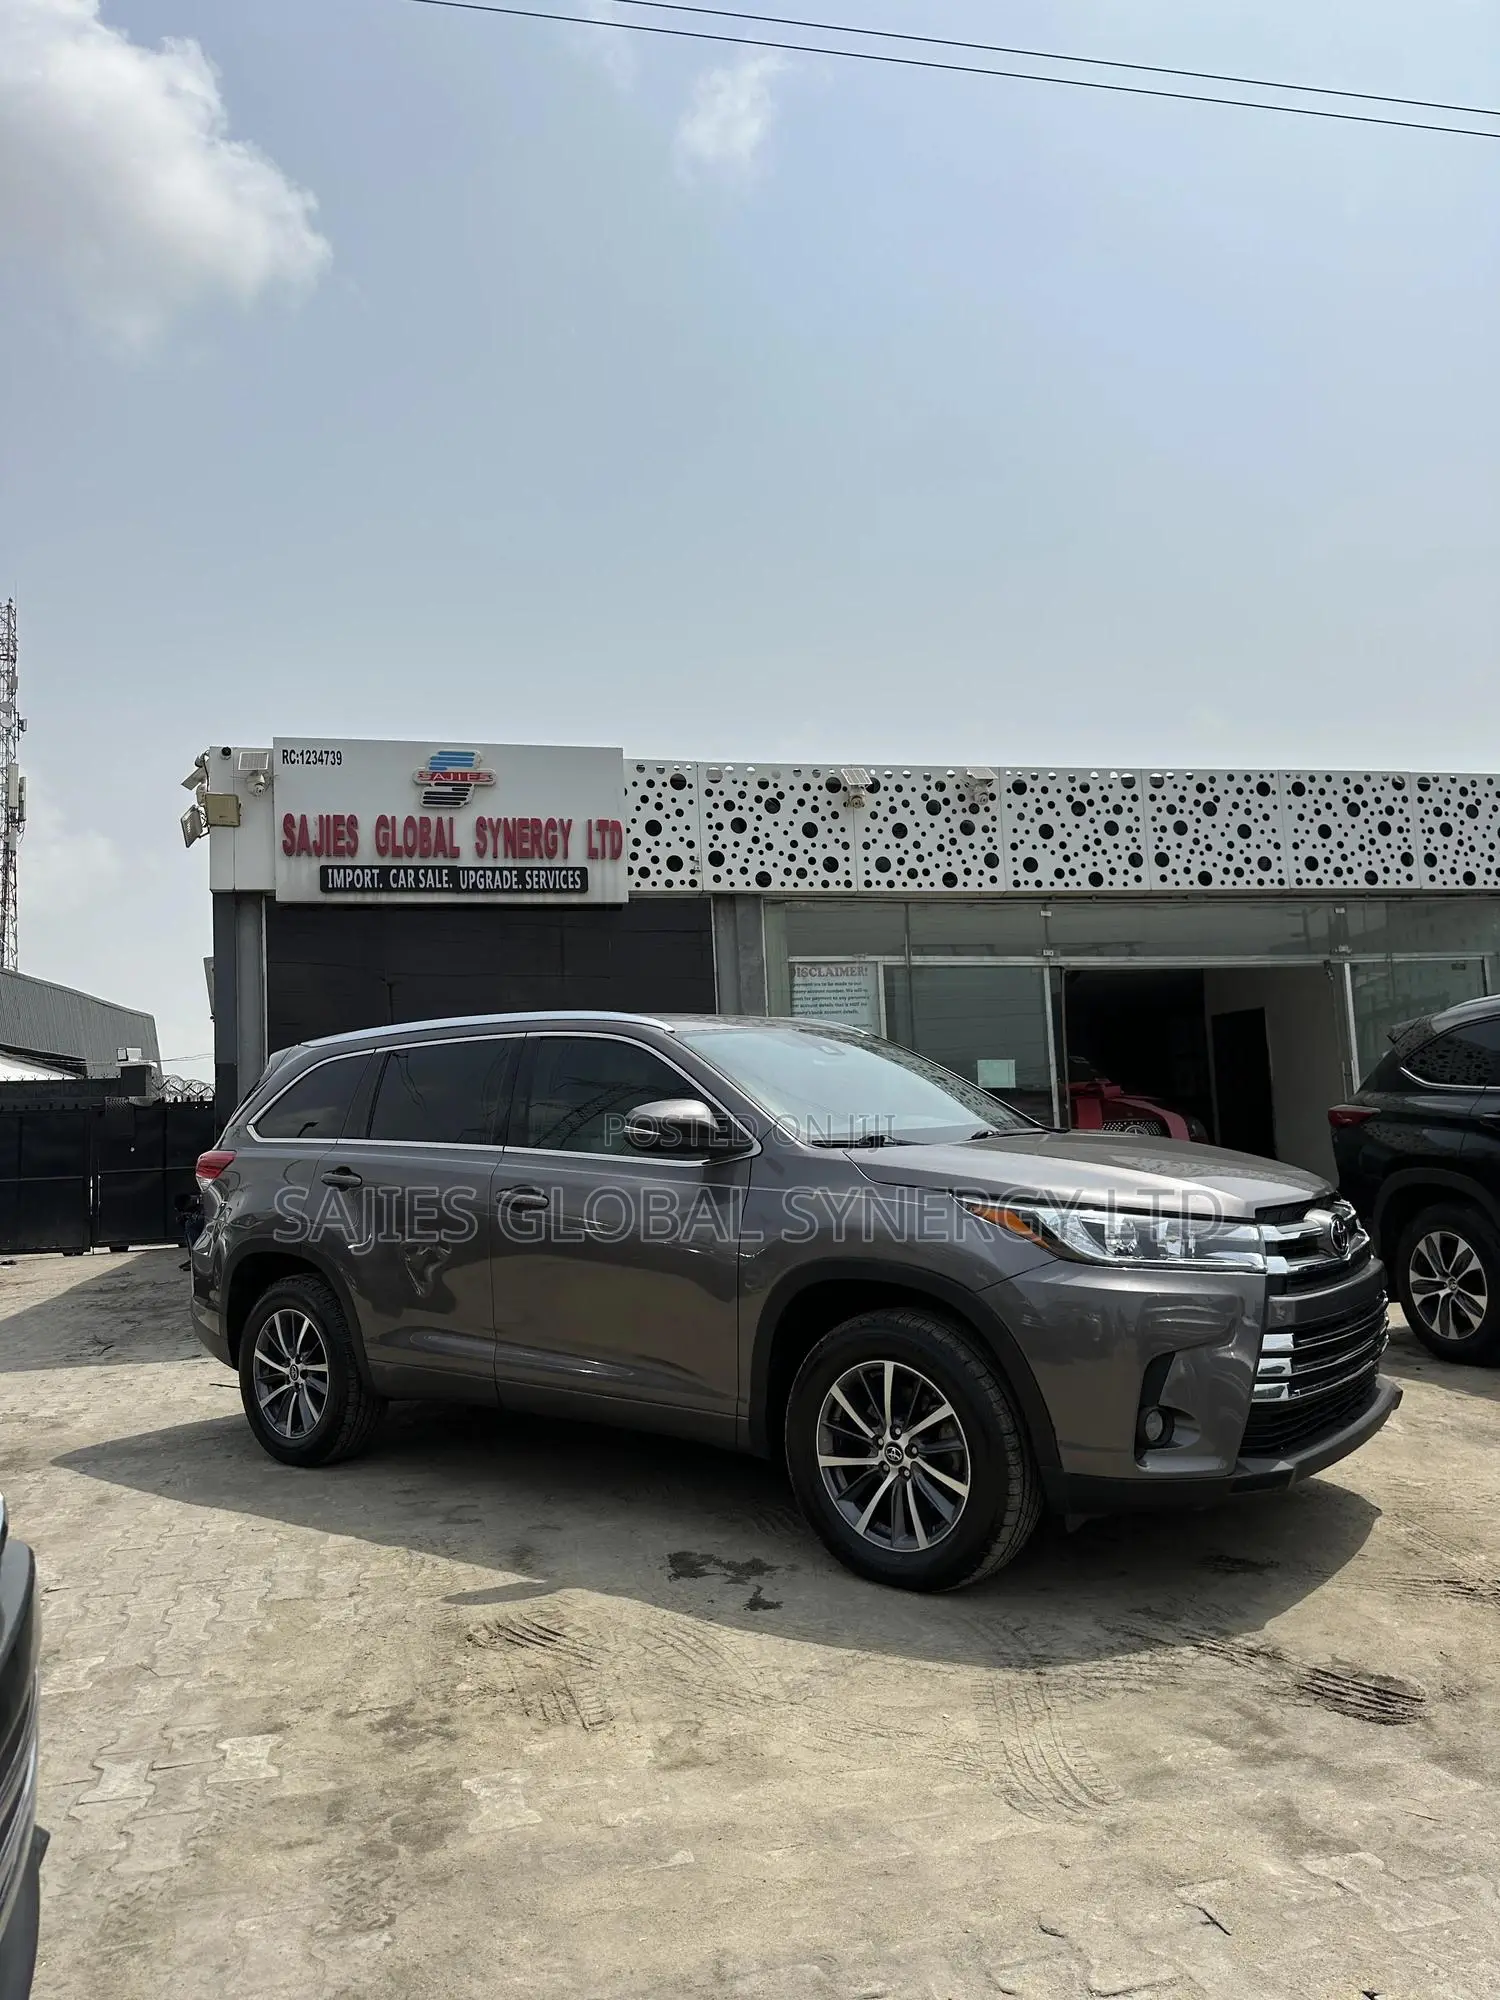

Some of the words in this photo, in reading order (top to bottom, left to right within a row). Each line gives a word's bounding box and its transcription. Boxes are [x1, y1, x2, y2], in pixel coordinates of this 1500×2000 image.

[282, 749, 342, 766] RC:1234739
[417, 771, 494, 782] SAJIES
[282, 813, 359, 857] SAJIES
[375, 815, 460, 858] GLOBAL
[475, 816, 573, 859] SYNERGY
[587, 818, 624, 860] LTD
[327, 869, 383, 889] IMPORT.
[389, 869, 416, 889] CAR
[418, 869, 453, 889] SALE.
[459, 870, 522, 890] UPGRADE.
[525, 870, 581, 890] SERVICES
